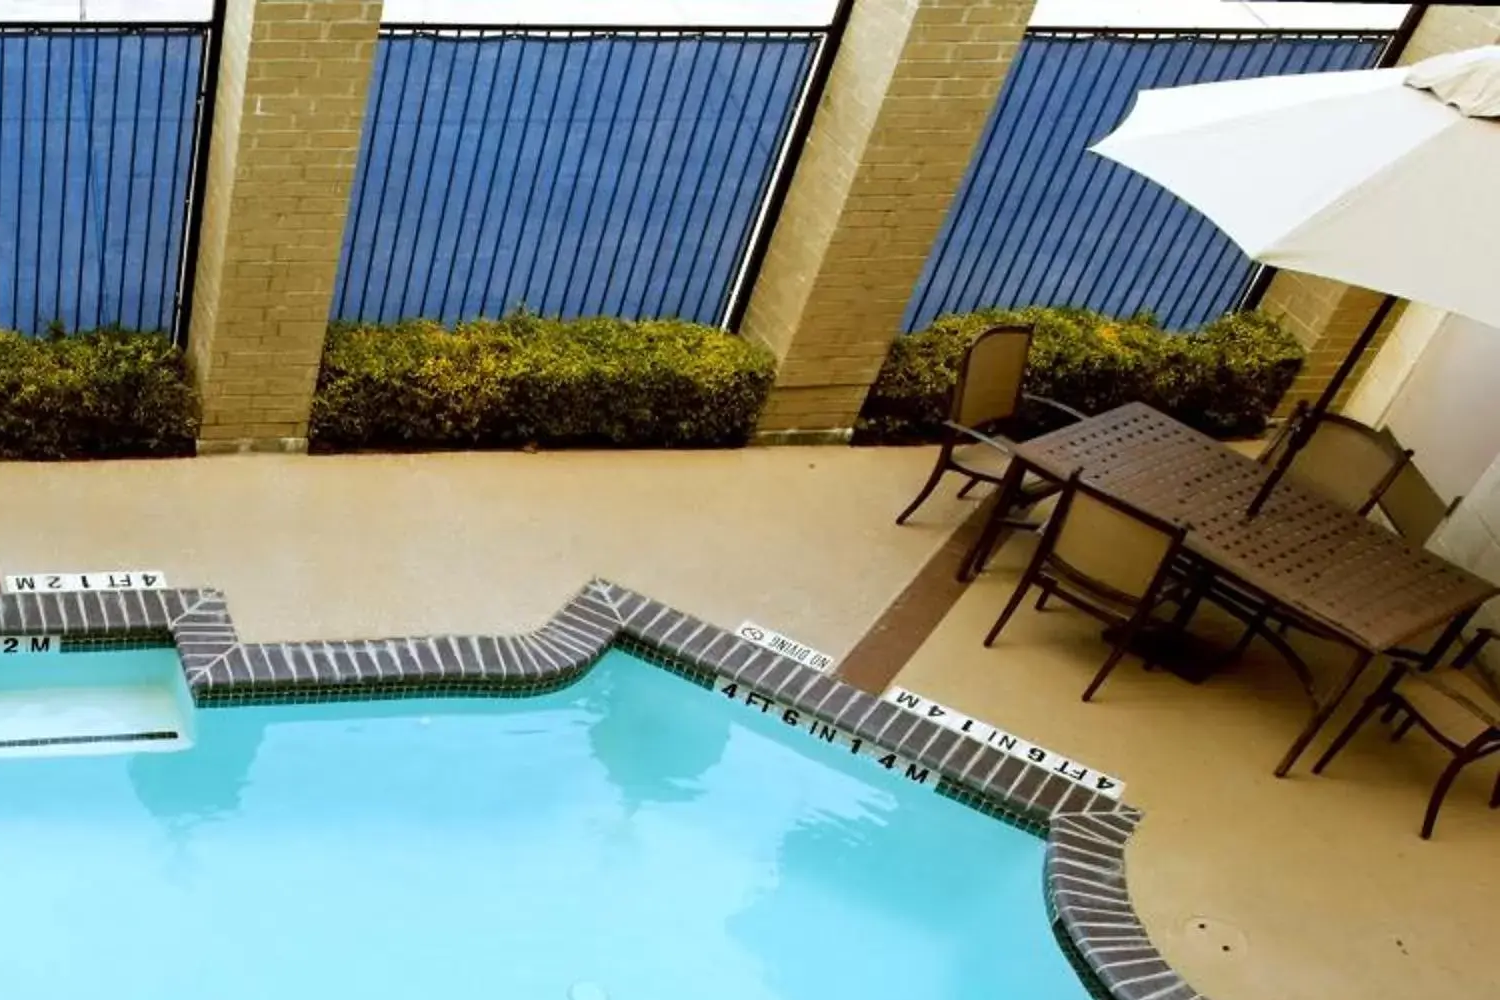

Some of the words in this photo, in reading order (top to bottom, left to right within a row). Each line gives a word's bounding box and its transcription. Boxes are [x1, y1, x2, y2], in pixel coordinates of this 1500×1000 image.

[16, 575, 36, 591] M
[108, 574, 133, 588] FT
[31, 637, 50, 653] M
[897, 690, 920, 709] M
[720, 683, 738, 700] 4
[745, 692, 775, 714] FT
[782, 708, 799, 726] 6
[810, 719, 838, 744] IN
[905, 763, 930, 784] M
[1027, 747, 1046, 763] 6
[1054, 762, 1089, 783] FT
[1095, 776, 1116, 791] 4
